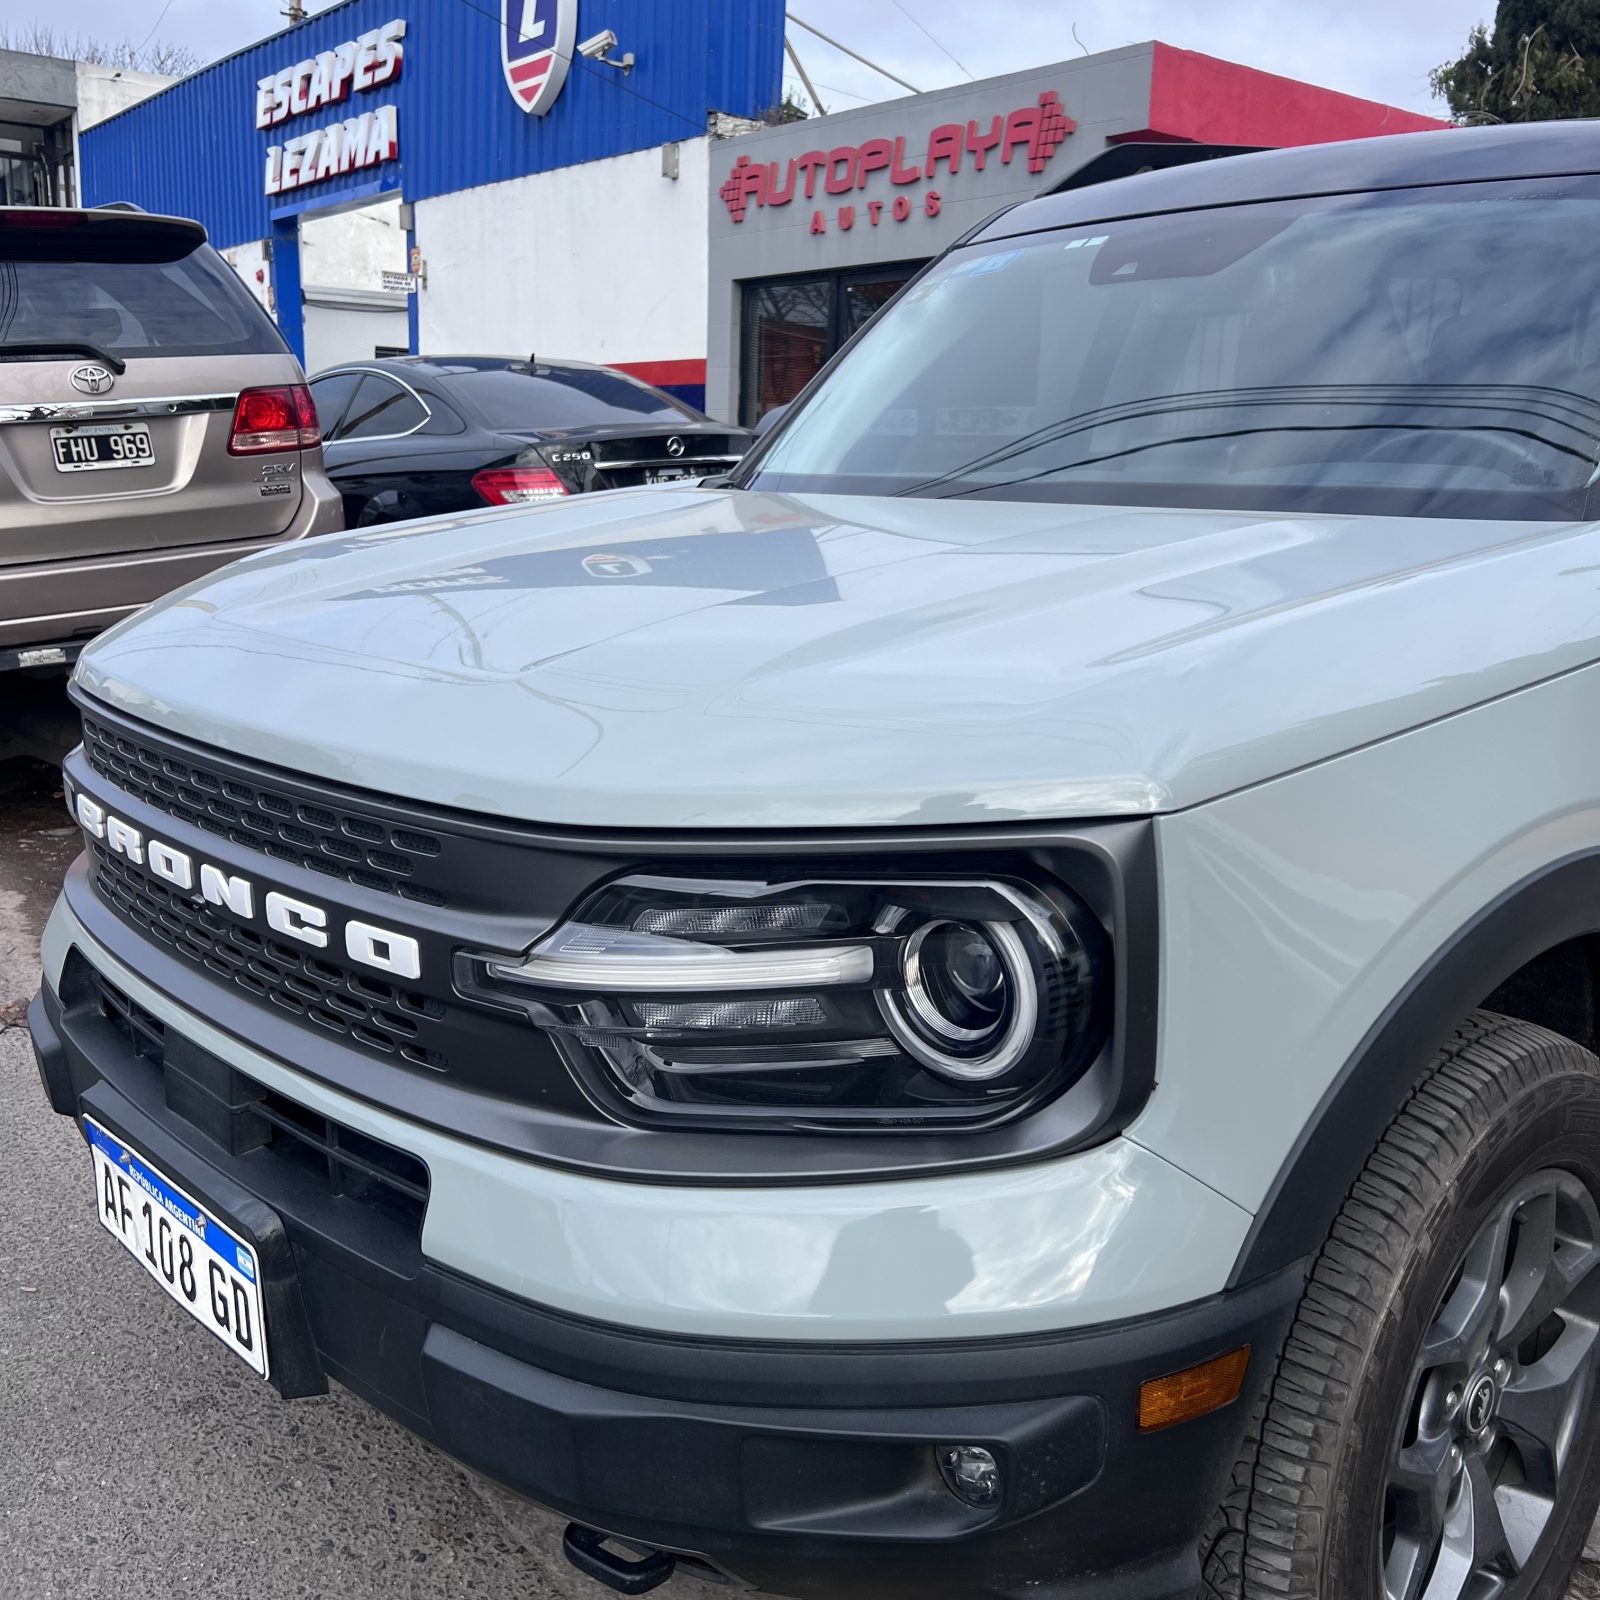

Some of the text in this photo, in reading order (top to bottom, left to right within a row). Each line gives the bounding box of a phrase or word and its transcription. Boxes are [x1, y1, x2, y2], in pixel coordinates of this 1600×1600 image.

[256, 18, 406, 129] ESCAPES
[265, 104, 397, 195] LEZAMA
[740, 106, 1044, 208] AUTOPLAYA
[810, 190, 942, 235] AUTOS
[56, 434, 151, 462] FHU 969
[552, 451, 591, 462] C 250
[77, 793, 421, 980] BRONCO
[104, 1162, 253, 1353] AF 108 GD
